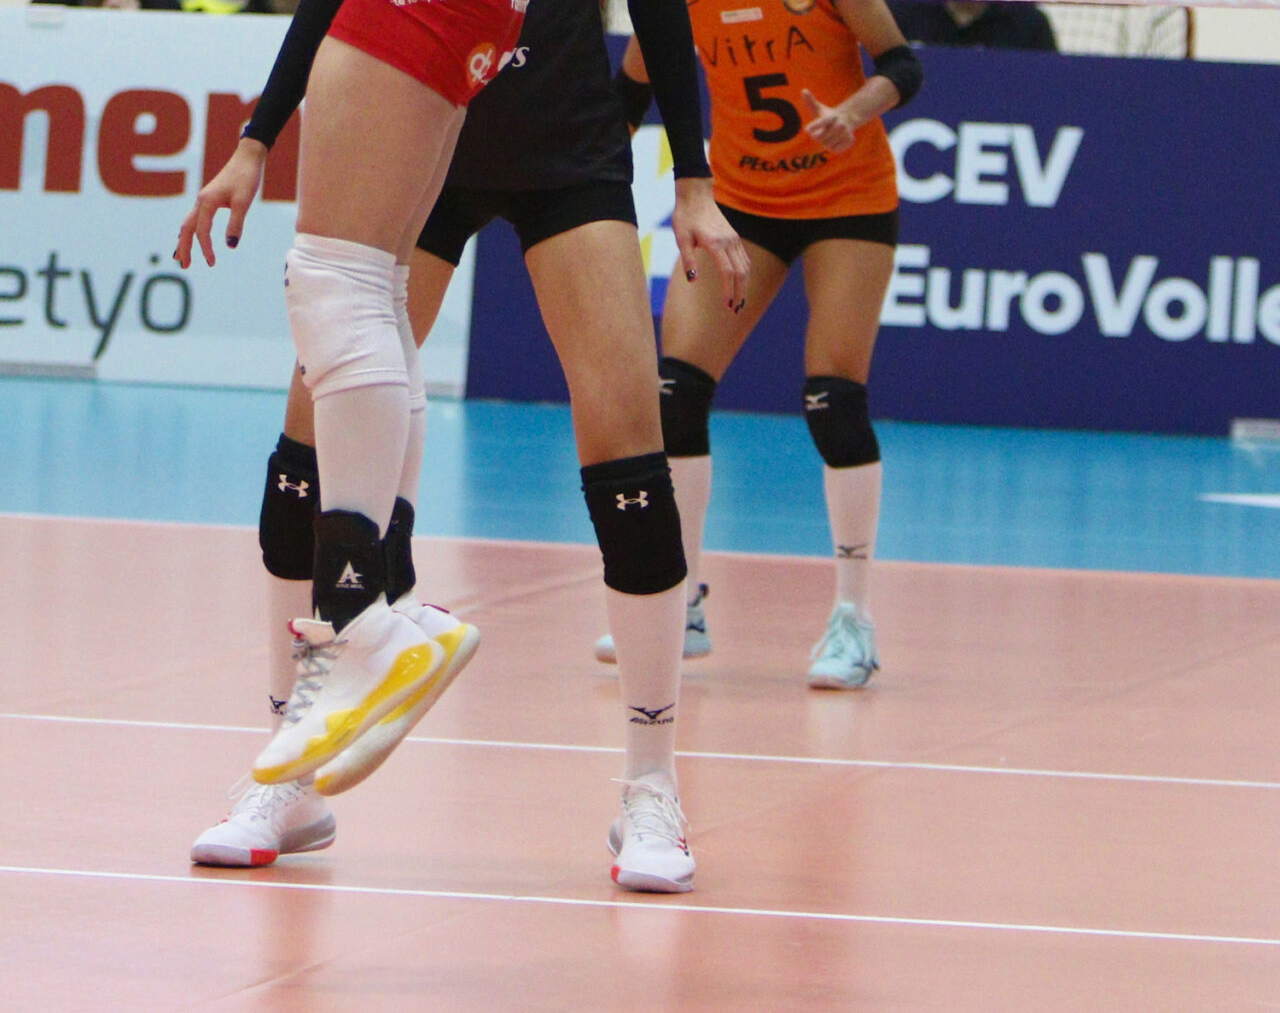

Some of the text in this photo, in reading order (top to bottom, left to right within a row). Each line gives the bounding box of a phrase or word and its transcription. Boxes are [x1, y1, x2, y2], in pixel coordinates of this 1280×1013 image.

[702, 25, 814, 68] VitrA
[743, 72, 803, 144] 5
[738, 151, 829, 173] PEGASUS
[888, 117, 1085, 208] CEV
